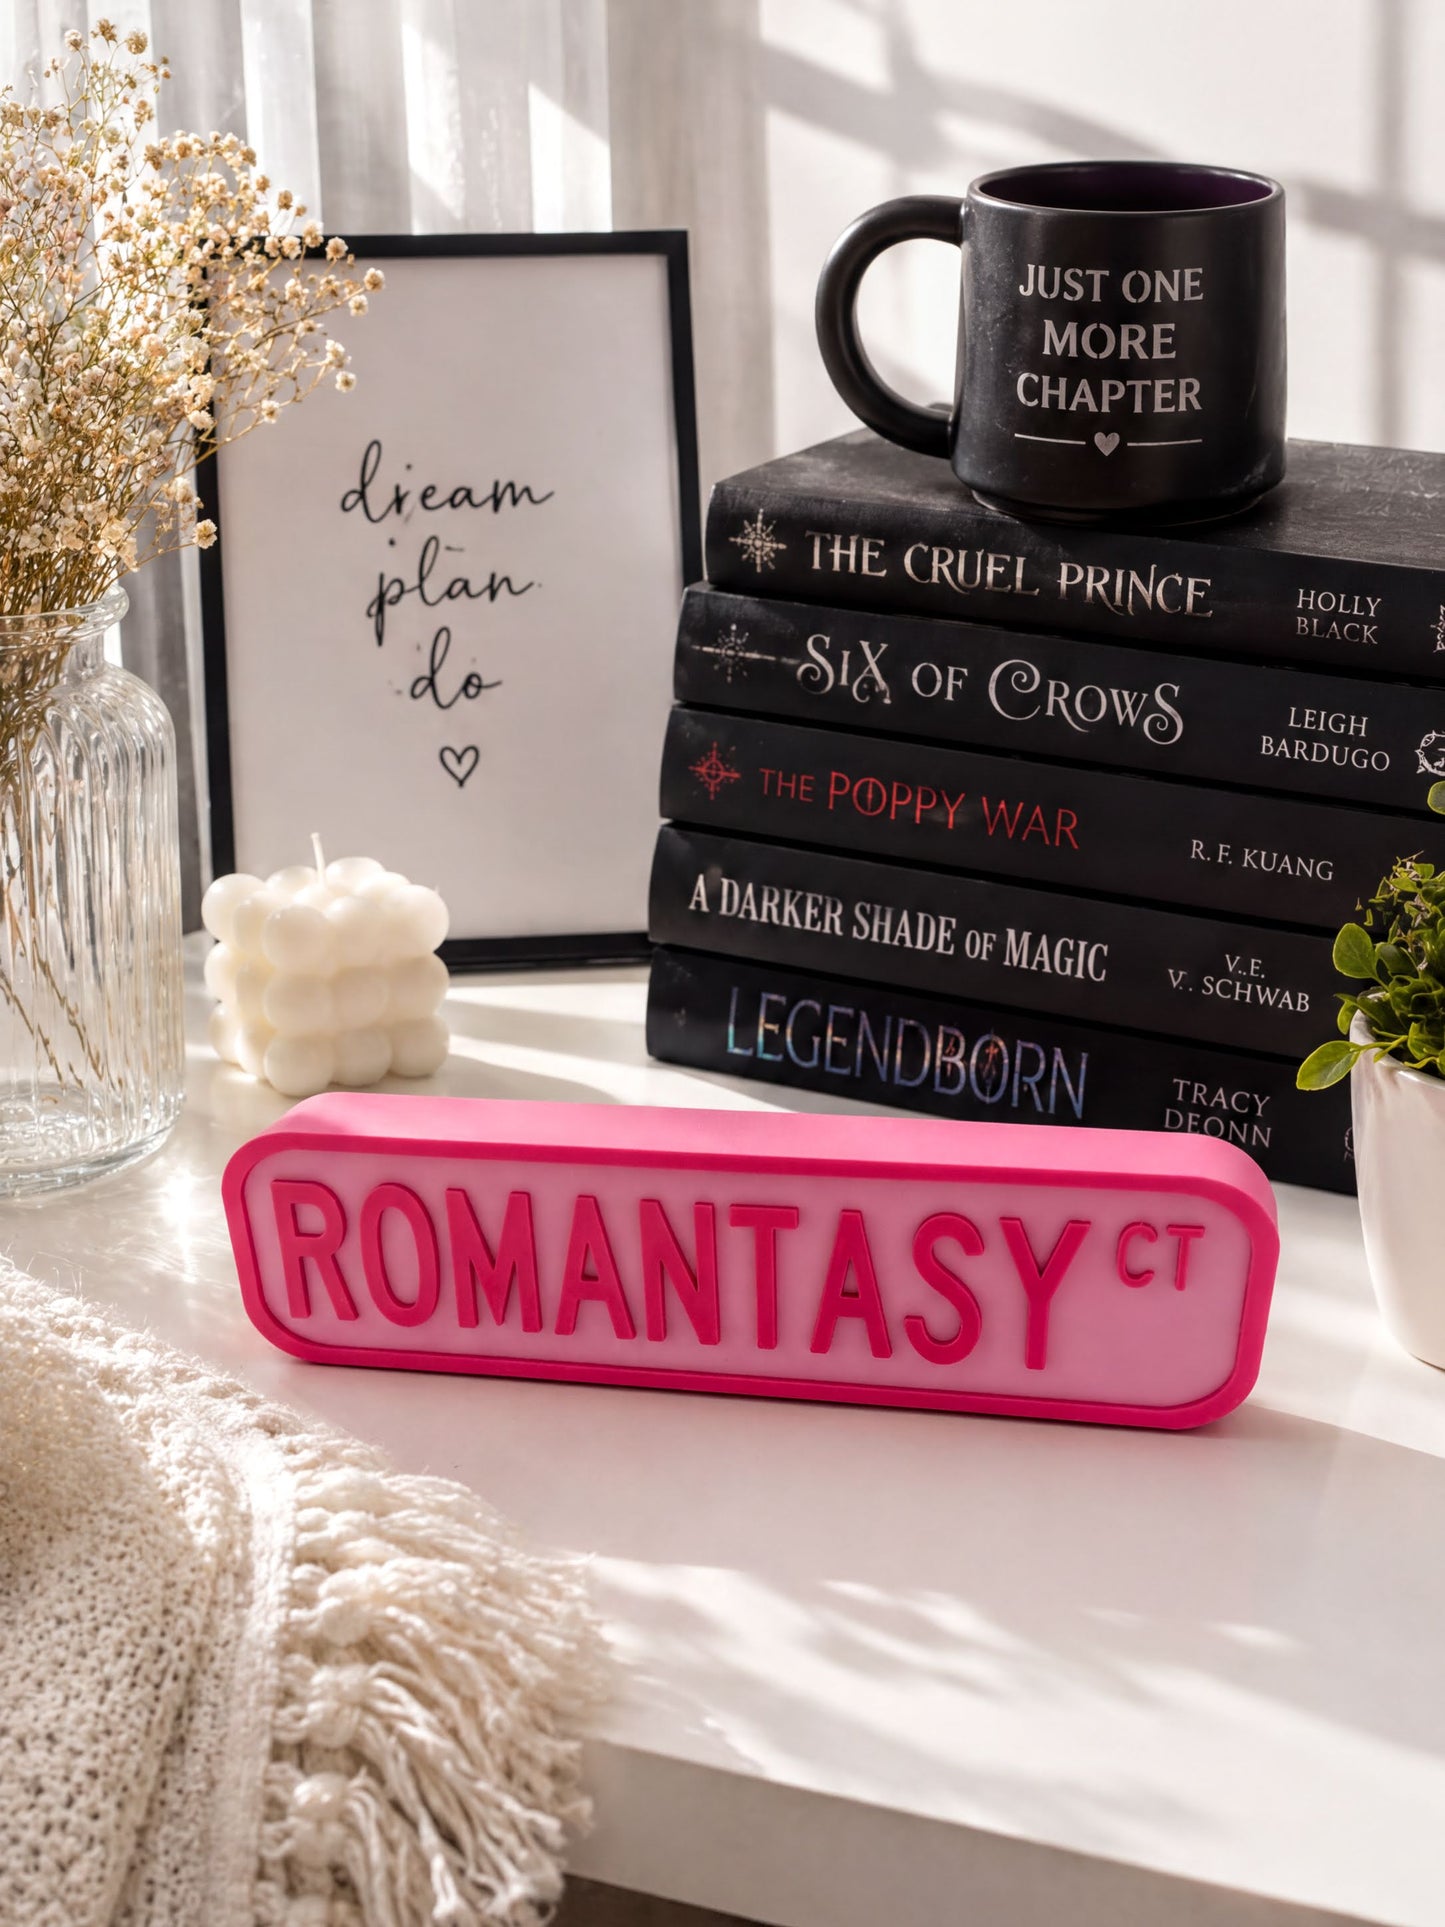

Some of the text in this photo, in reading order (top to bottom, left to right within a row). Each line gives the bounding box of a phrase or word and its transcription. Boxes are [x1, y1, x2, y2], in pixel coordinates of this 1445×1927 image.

[1019, 264, 1204, 303] JUST ONE
[1042, 319, 1177, 360] MORE
[1016, 372, 1203, 414] CHAPTER
[341, 439, 555, 523] dream
[366, 535, 535, 647] plan
[805, 530, 1214, 618] THE CRUEL PRINCE
[1296, 588, 1382, 617] HOLLY
[1295, 616, 1379, 645] BLACK
[410, 626, 502, 709] do
[911, 662, 969, 702] OF
[988, 658, 1184, 746] CROWS
[1288, 706, 1369, 738] LEIGH
[1260, 735, 1391, 772] BARDUGO
[759, 767, 1080, 850] THE POPPY WAR
[1190, 839, 1334, 881] R. F. KUANG
[688, 873, 1109, 983] A DARKER SHADE OF MAGIC
[1201, 975, 1311, 1013] SCHWAB
[727, 986, 1090, 1119] LEGENDBORN
[1172, 1078, 1271, 1118] TRACY
[1164, 1108, 1273, 1149] DEONN
[270, 1179, 1206, 1371] ROMANTASY CT
